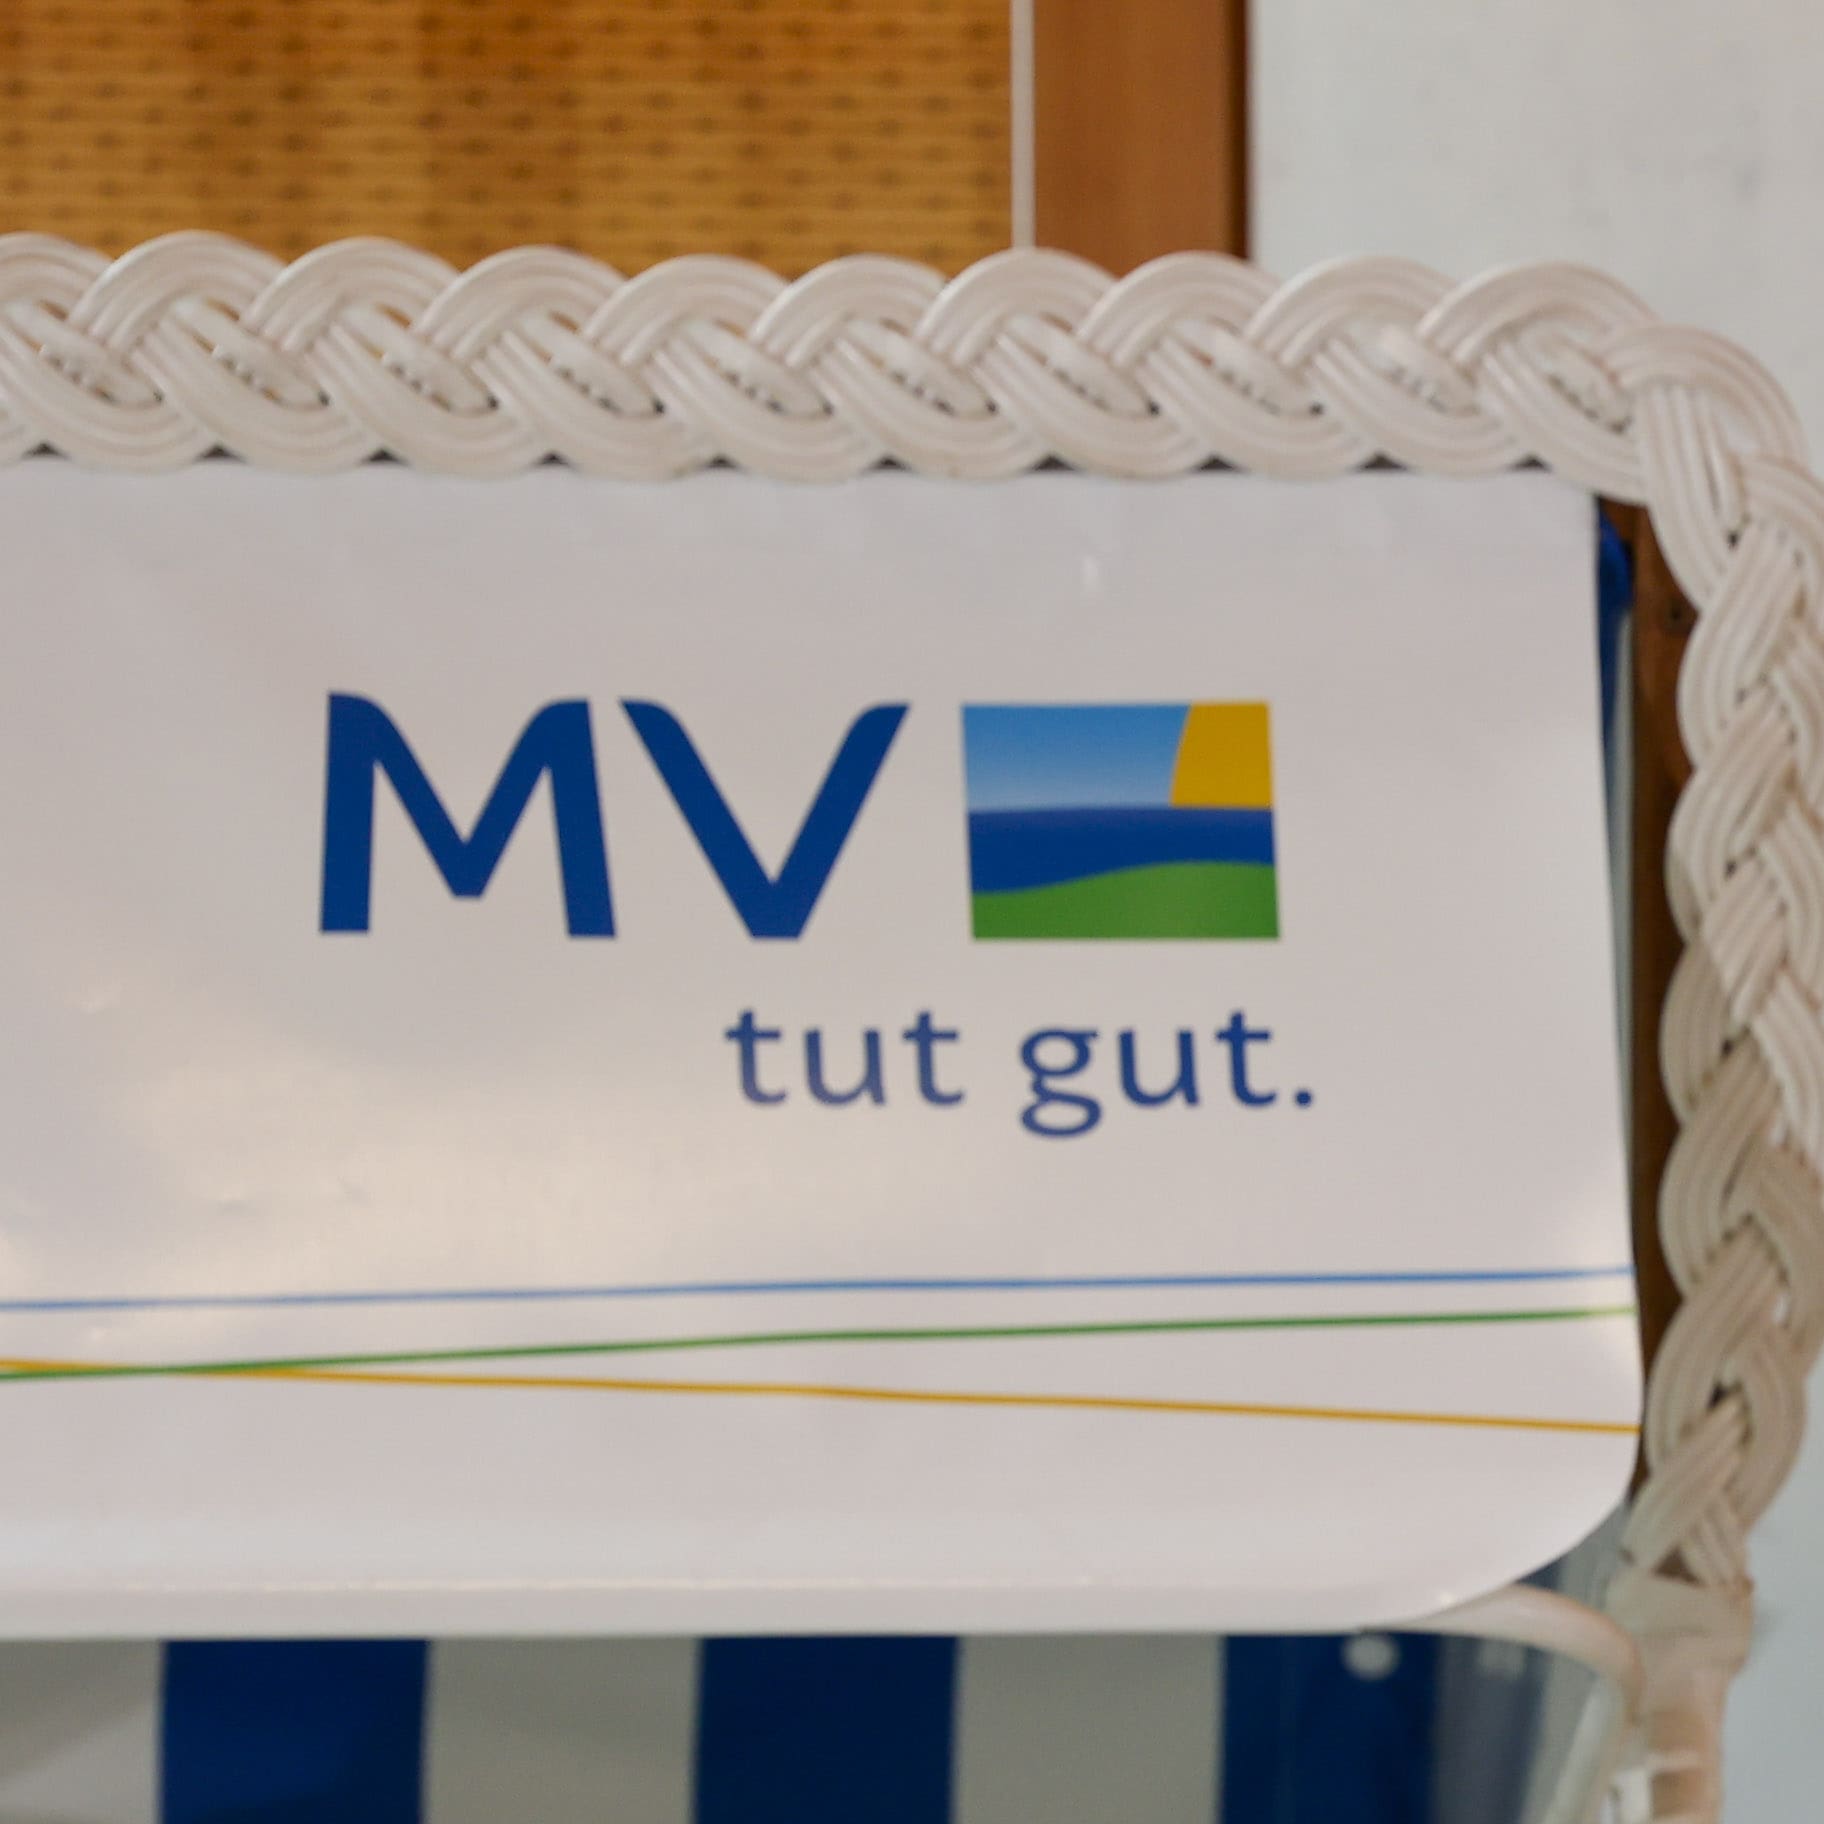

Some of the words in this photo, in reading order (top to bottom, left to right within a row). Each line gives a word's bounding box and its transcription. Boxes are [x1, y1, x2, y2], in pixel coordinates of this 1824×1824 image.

[319, 691, 911, 941] MV
[724, 1010, 965, 1106] tut
[1019, 1011, 1314, 1138] gut.
